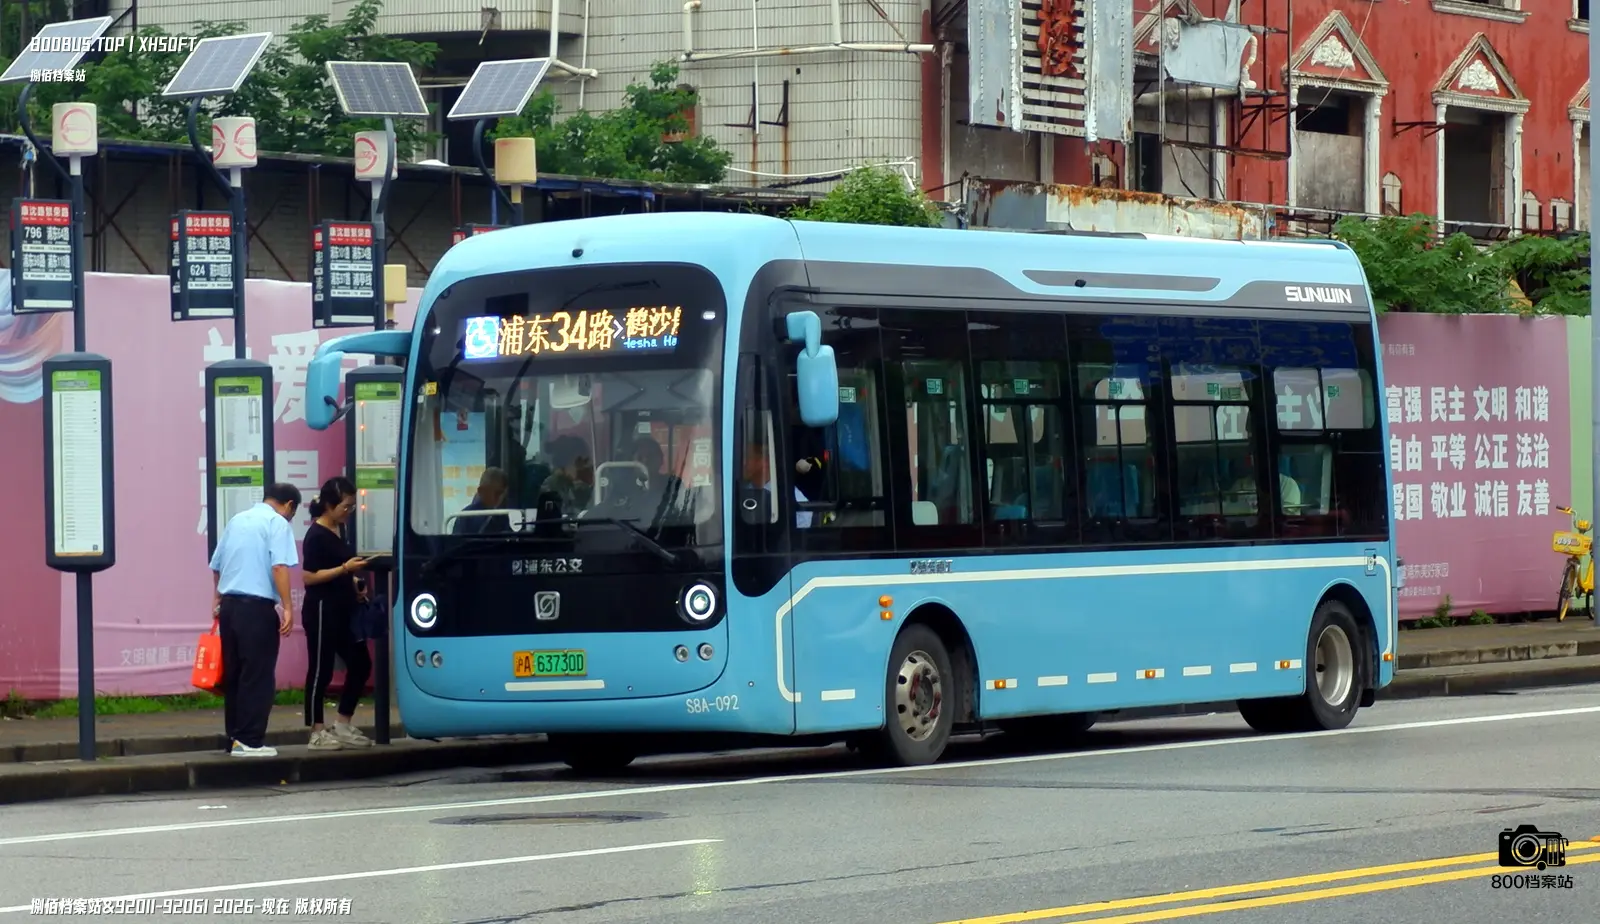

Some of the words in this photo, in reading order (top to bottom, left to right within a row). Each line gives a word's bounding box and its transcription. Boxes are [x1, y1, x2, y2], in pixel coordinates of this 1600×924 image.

[24, 226, 42, 239] 796
[190, 264, 206, 276] 624
[1285, 286, 1352, 304] SUNWIN
[499, 309, 614, 356] 浦东34路
[1386, 384, 1422, 424] 富强
[1430, 384, 1466, 422] 民主
[1473, 385, 1508, 422] 文明
[1515, 385, 1549, 422] 和谐
[1389, 434, 1422, 472] 自由
[1430, 433, 1466, 471] 平等
[1474, 433, 1509, 469] 公正
[1516, 432, 1549, 469] 法治
[1392, 482, 1423, 520] 爱国
[1430, 481, 1467, 519] 敬业
[1474, 480, 1508, 517] 诚信
[1516, 478, 1550, 516] 友善
[524, 558, 583, 575] 浦东公交
[686, 695, 739, 713] S8A-092
